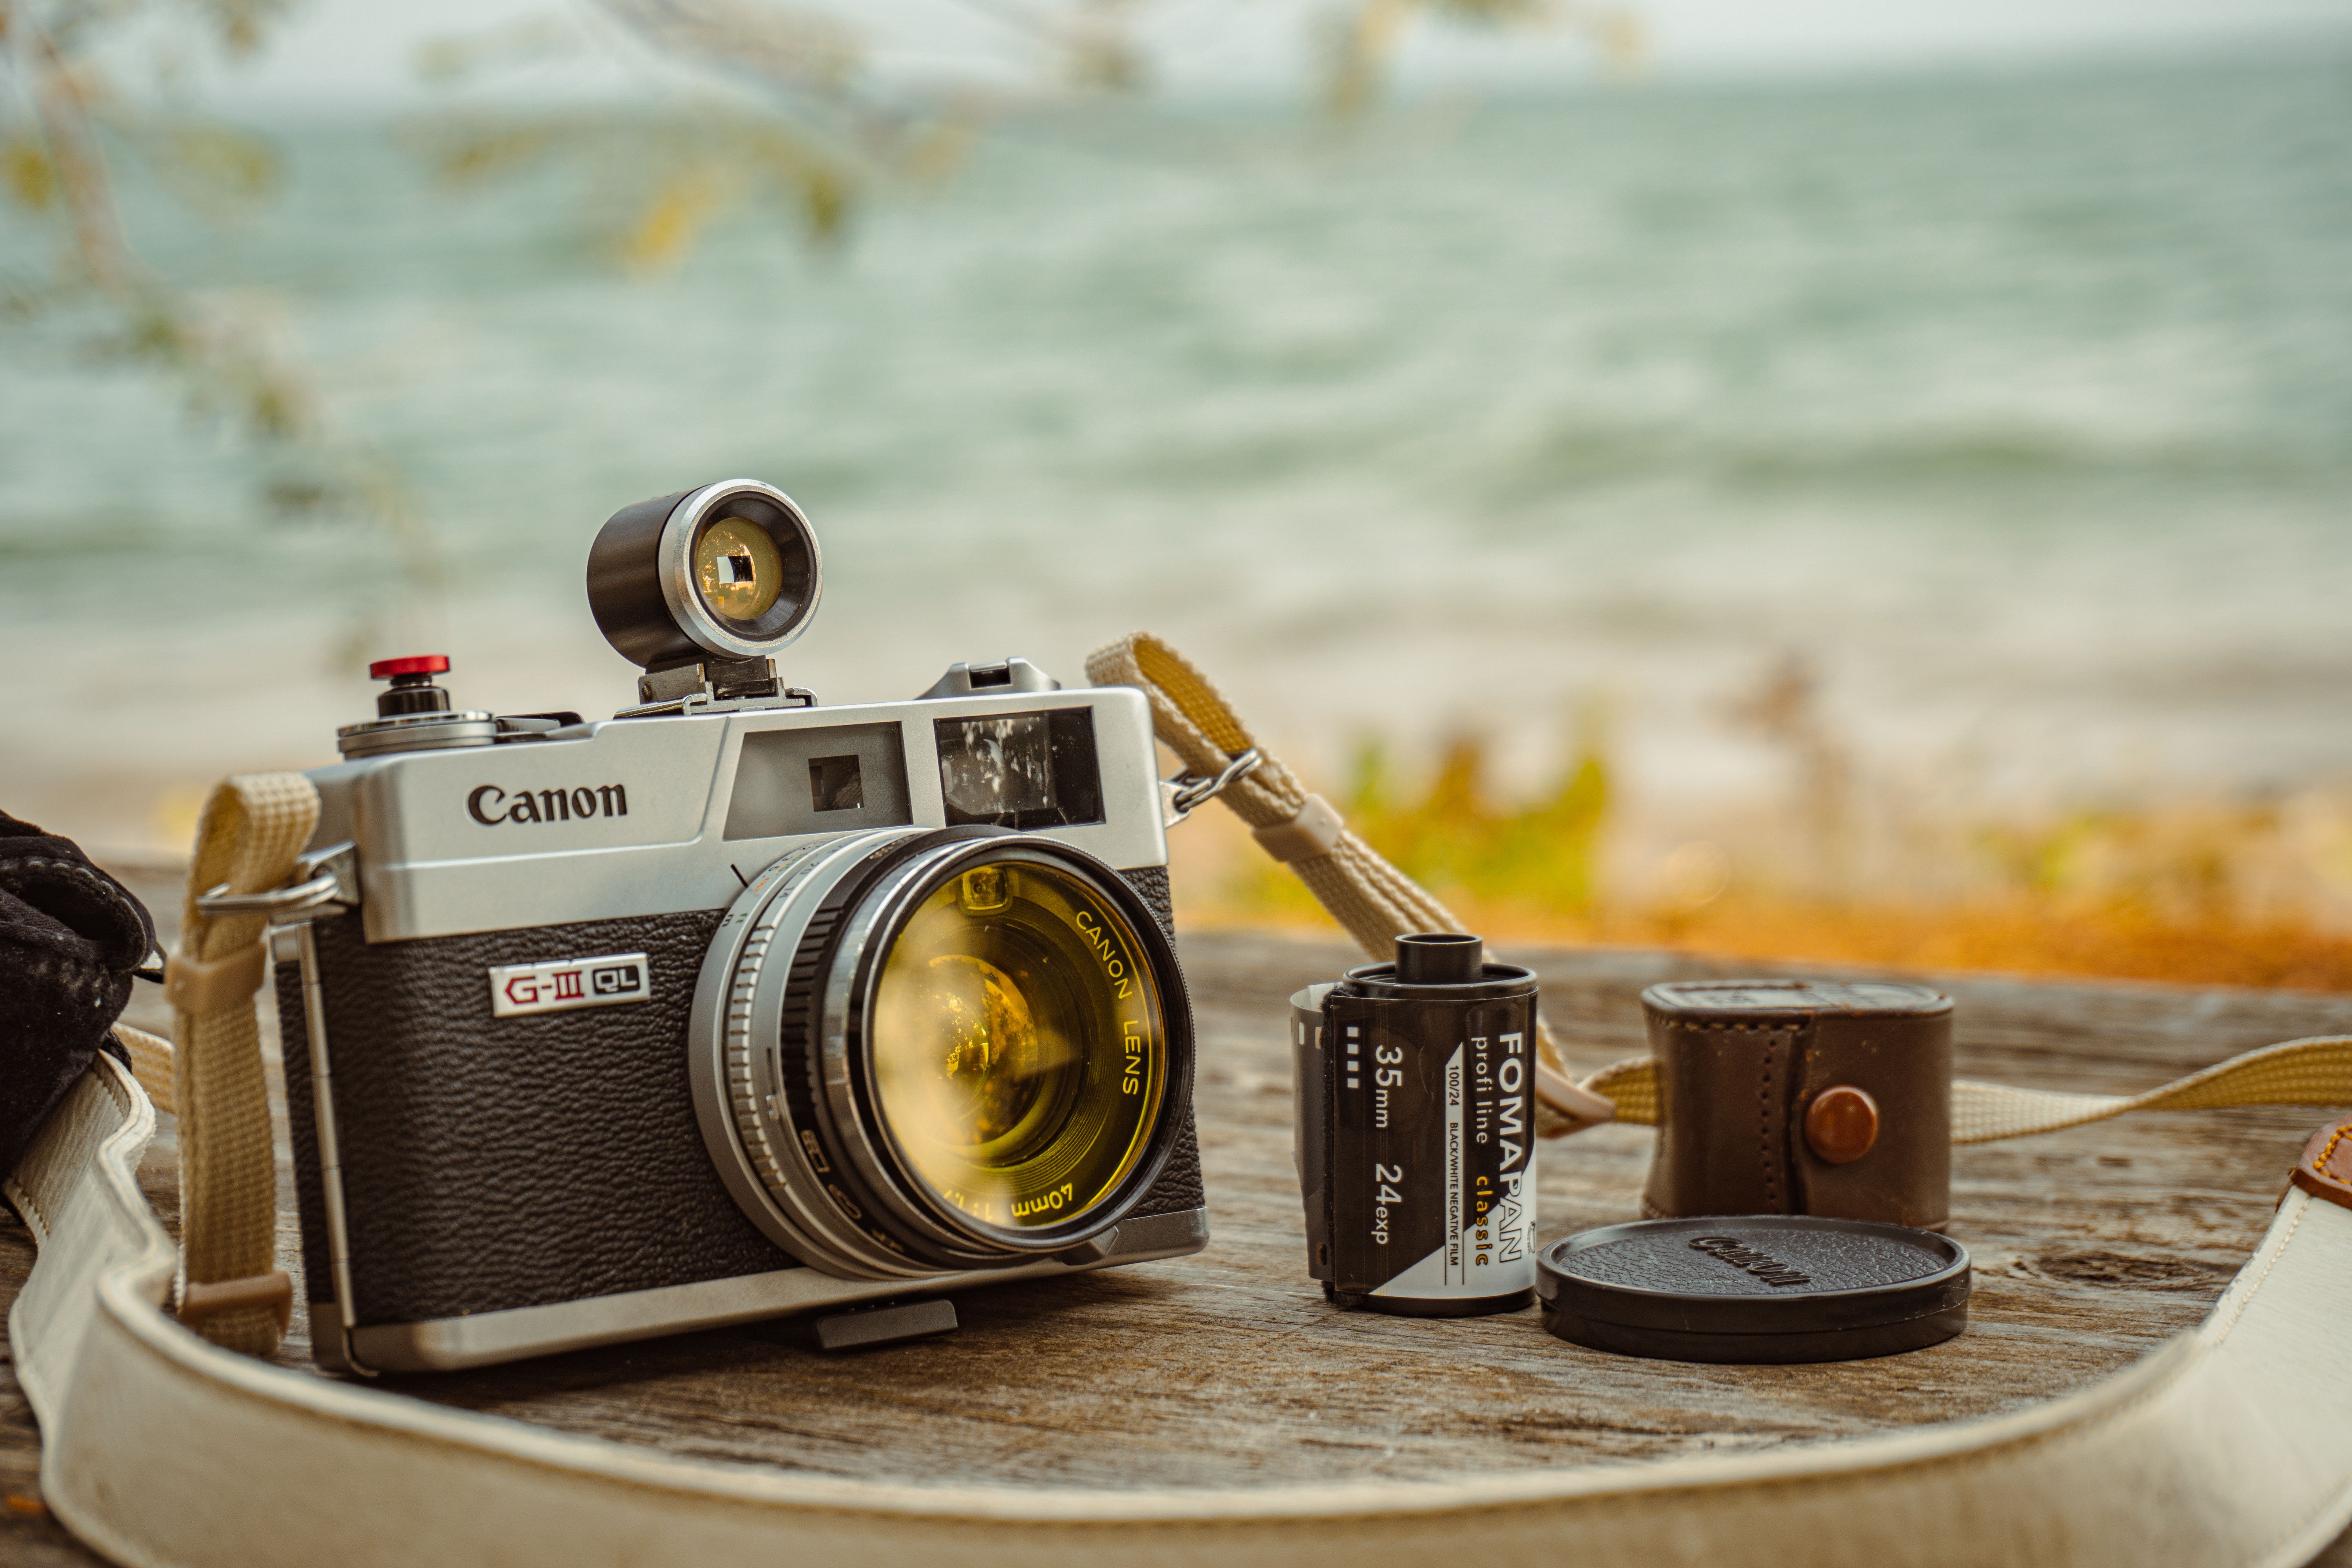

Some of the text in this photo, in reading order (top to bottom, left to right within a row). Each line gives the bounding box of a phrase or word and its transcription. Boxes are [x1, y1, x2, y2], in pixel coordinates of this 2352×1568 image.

[468, 784, 627, 826] Canon
[505, 968, 638, 1004] G-III QL
[1076, 911, 1141, 1095] CANON LENS
[1011, 1182, 1072, 1217] 40mm
[1371, 1045, 1403, 1245] 35mm 24exp
[1449, 1065, 1459, 1266] 100/24 BLACK/WHITE NEGATIVE FILM
[1471, 1037, 1493, 1266] profi line classic
[1499, 1032, 1523, 1263] FOMAPAN
